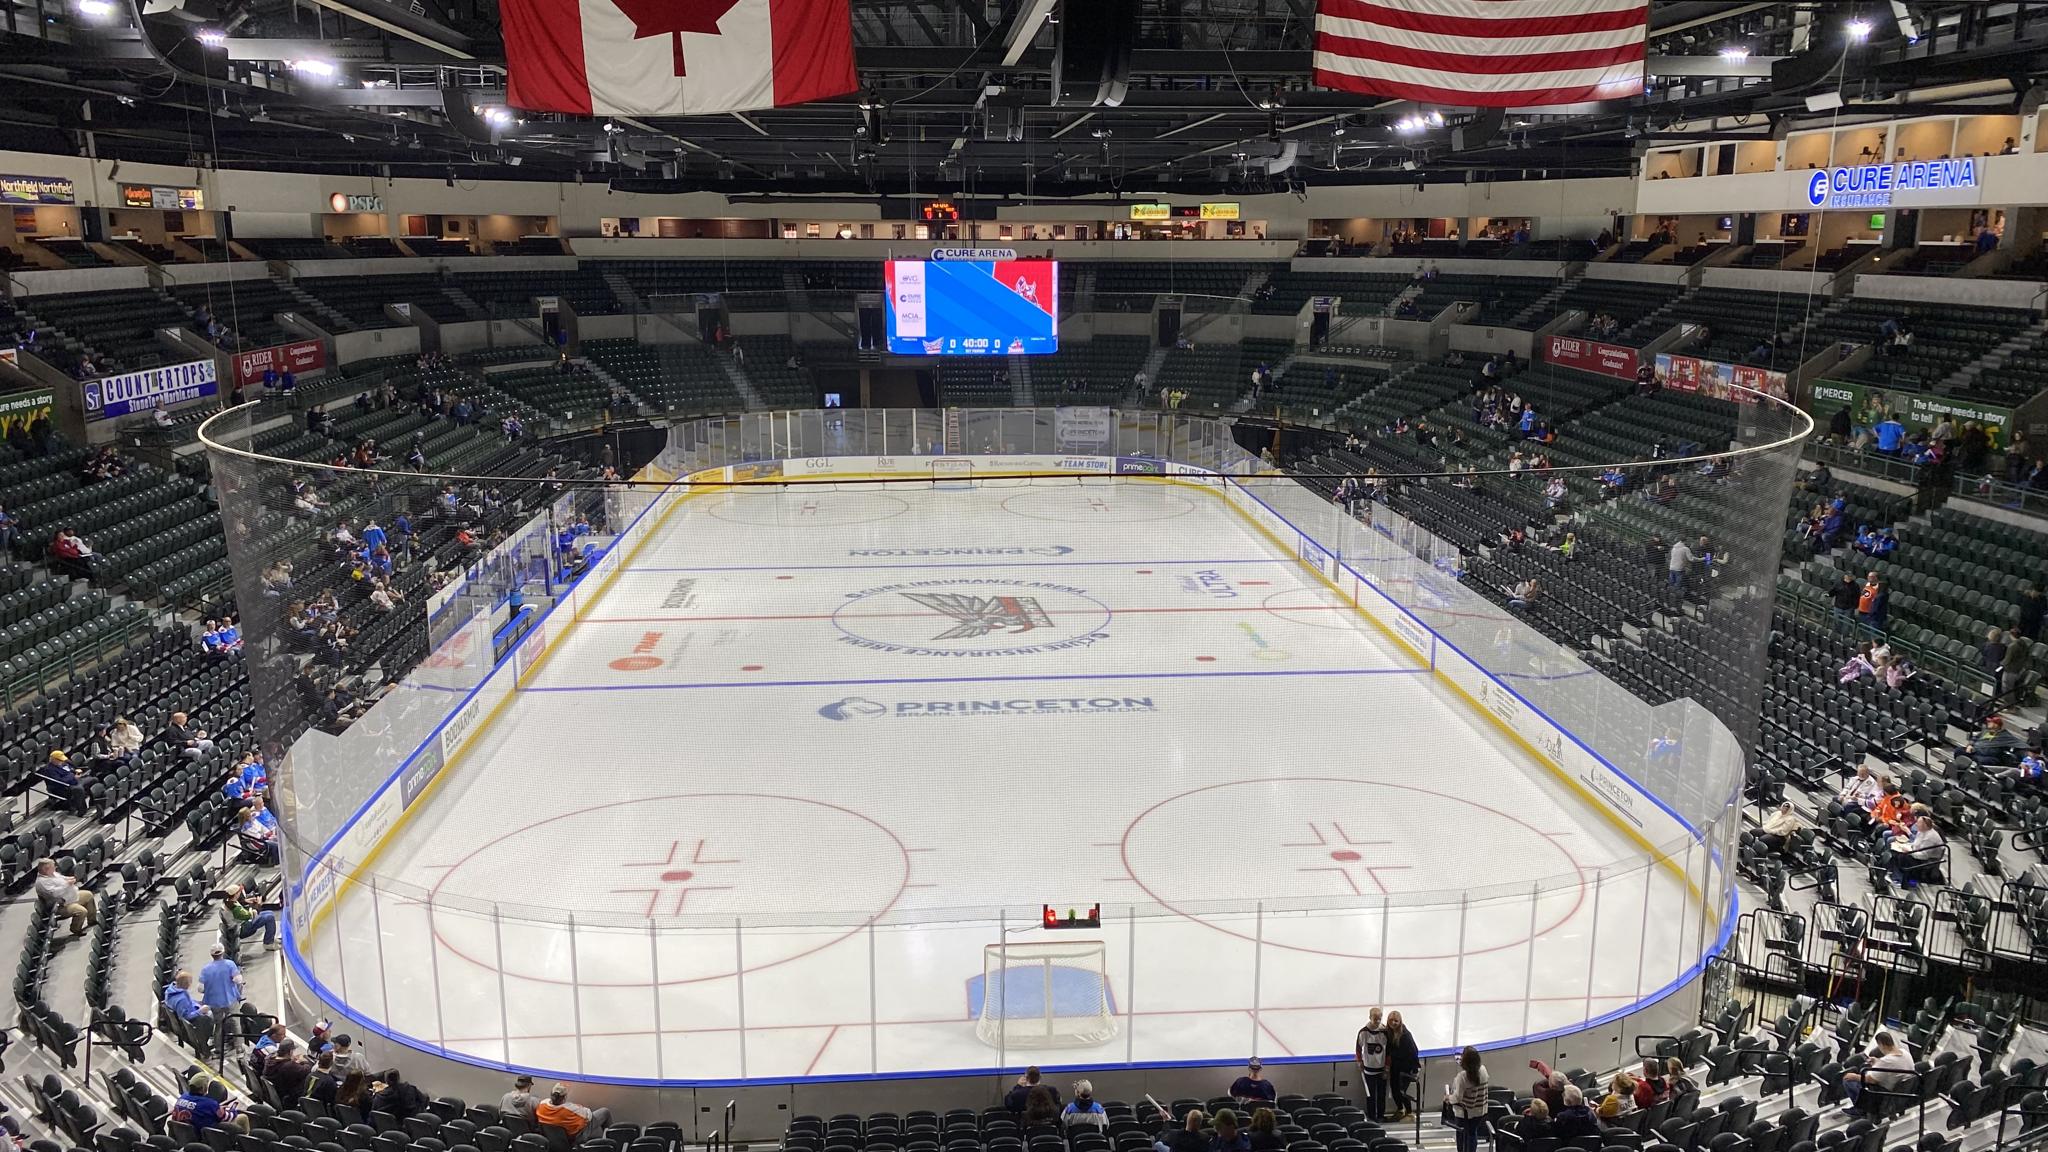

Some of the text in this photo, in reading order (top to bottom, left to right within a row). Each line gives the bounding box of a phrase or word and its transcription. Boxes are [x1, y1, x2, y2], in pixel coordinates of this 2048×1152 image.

[1833, 159, 1977, 192] CURE ARENA
[0, 179, 73, 194] Northfield Northfield
[348, 196, 384, 211] PSEG
[1830, 194, 1891, 208] INSURANCE
[946, 249, 1013, 257] CURE ARENA
[962, 338, 989, 348] 40:00
[1560, 339, 1580, 353] RIDER
[251, 350, 273, 366] RIDER
[106, 362, 205, 402] COUNTERTOPS
[1822, 387, 1853, 401] MERCER
[10, 397, 31, 410] needs
[31, 397, 36, 406] a
[36, 394, 53, 405] story
[1911, 411, 1933, 424] to tell
[1913, 398, 2006, 425] The future needs a story
[805, 458, 834, 469] GGL
[1064, 460, 1109, 470] TEAM STORE
[896, 696, 1155, 713] PRINCETON
[444, 699, 480, 749] BODYARMOR
[1599, 772, 1634, 808] PRINCETON
